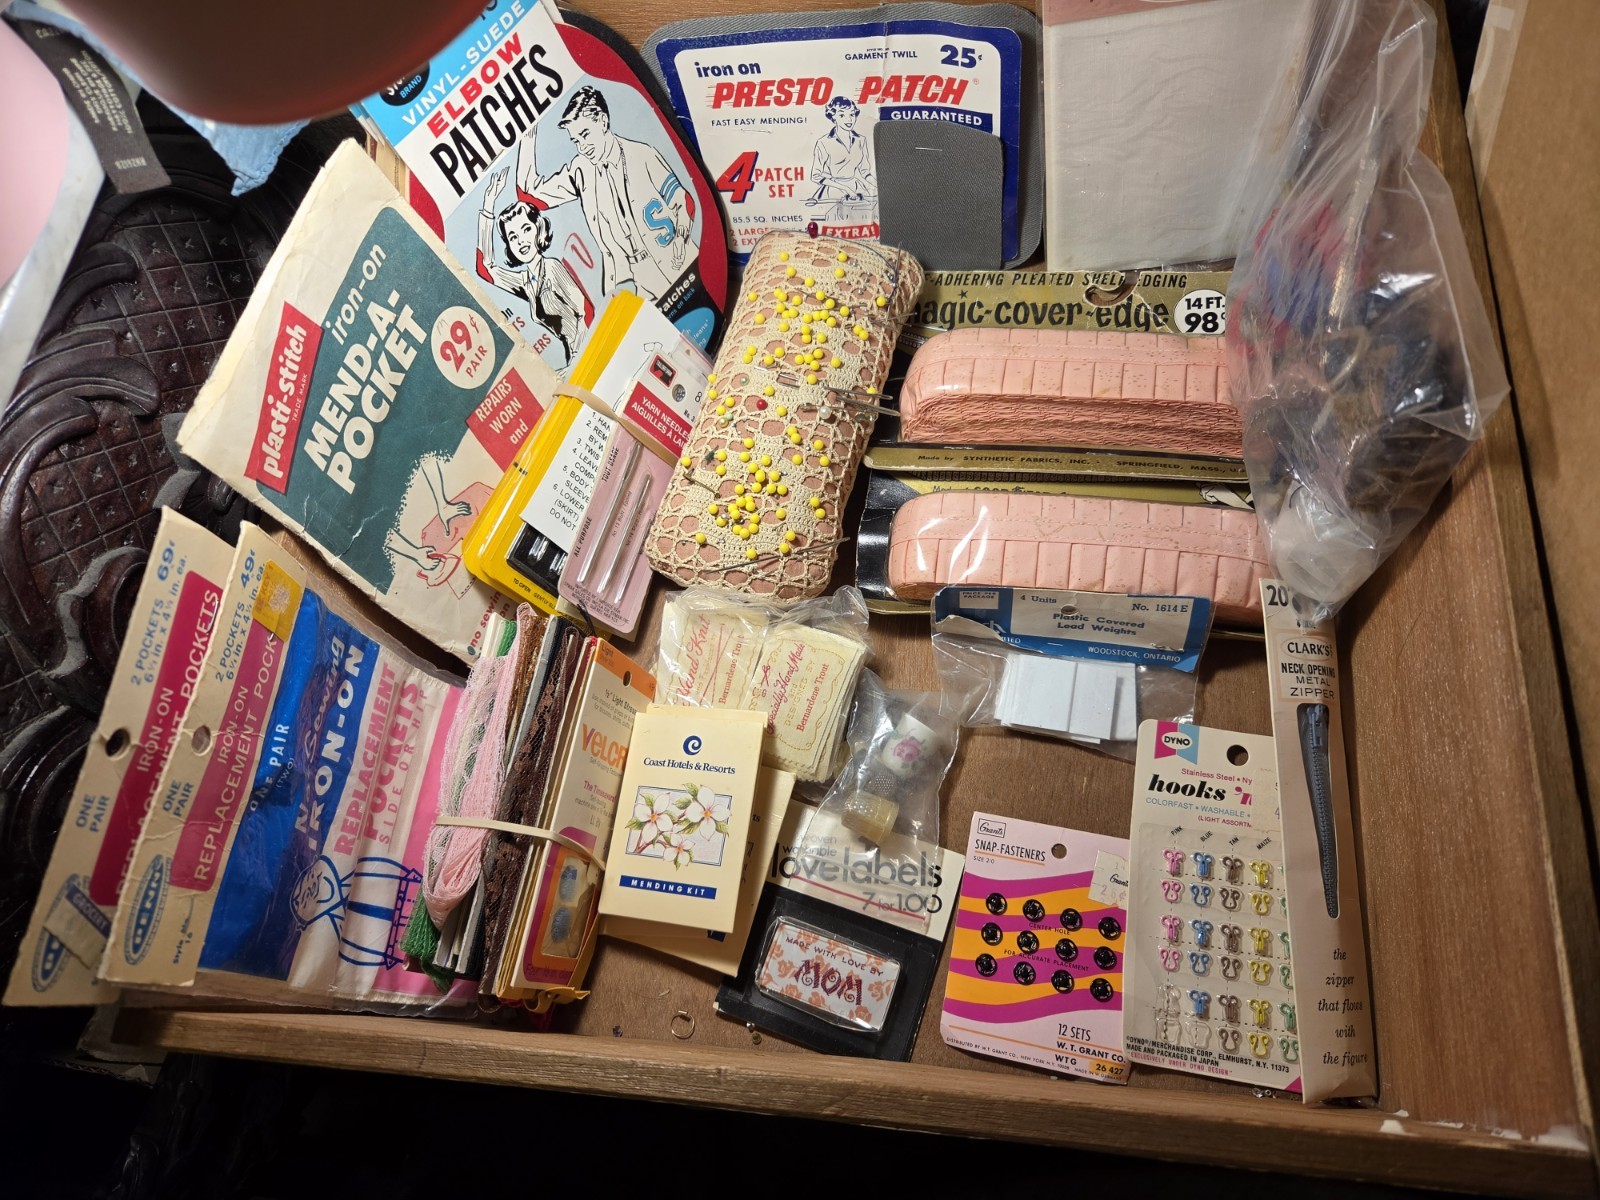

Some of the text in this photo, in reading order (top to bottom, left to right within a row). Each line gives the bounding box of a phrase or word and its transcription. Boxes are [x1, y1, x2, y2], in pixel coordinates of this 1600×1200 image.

[845, 51, 918, 61] GARMENT TWILL
[694, 61, 762, 78] iron on
[400, 74, 422, 99] BRAND
[427, 32, 522, 139] ELBOW
[711, 74, 969, 110] PRESTO PATCH
[430, 44, 563, 198] PATCHES
[711, 117, 807, 127] FAST EASY MENDING!
[890, 110, 983, 126] GUARANTEED
[715, 151, 759, 204] 4
[755, 166, 804, 183] PATCH
[768, 184, 795, 198] SET
[732, 216, 751, 224] 85.5
[772, 215, 803, 223] INCHES
[826, 226, 876, 238] EXTRA!
[1011, 273, 1075, 287] PLEATED
[1136, 274, 1188, 288] DGING
[325, 243, 387, 346] iron-on
[1185, 296, 1226, 310] 14 FT.
[440, 313, 480, 374] 29¢
[465, 345, 488, 379] PAIR
[262, 323, 307, 479] plasti-stitch
[291, 373, 308, 423] TRADE MARK
[327, 303, 428, 495] POCKET
[474, 378, 513, 422] REPAIRS
[641, 396, 661, 417] YARN
[489, 397, 523, 434] WORN
[631, 401, 667, 434] AIGUILLES
[509, 418, 529, 445] and
[573, 516, 593, 558] ALL PURPOSE
[512, 577, 532, 594] TO OPEN
[1031, 595, 1057, 604] Units
[1131, 603, 1149, 612] No.
[1052, 613, 1145, 629] Plastic Covered
[1057, 622, 1137, 636] Lead Weights
[180, 588, 219, 700] POCKETS
[219, 602, 246, 668] POCKETS
[1143, 652, 1181, 663] ONTARIO
[1287, 641, 1330, 657] CLARK'S
[1281, 662, 1336, 679] NECK OPENING
[1295, 675, 1331, 687] METAL
[796, 663, 830, 733] Bernardene Trout
[1290, 687, 1334, 699] ZIPPER
[136, 686, 175, 772] IRON-ON
[217, 686, 249, 764] IRON-ON
[269, 723, 290, 767] PAIR
[308, 644, 364, 851] IRON-ON
[1163, 735, 1191, 746] DYNO
[193, 633, 279, 880] REPLACEMENT POCK
[333, 661, 396, 856] REPLACEMENT
[363, 680, 419, 840] POCKETS
[378, 688, 428, 845] SIDE OR HIP
[643, 756, 736, 775] Coast Hotels & Resorts
[1181, 768, 1236, 782] Stainless Steel
[161, 780, 182, 813] ONE
[1148, 773, 1227, 801] hooks
[173, 782, 194, 818] PAIR
[1145, 797, 1245, 818] COLORFAST WASHABLE
[76, 794, 95, 828] ONE
[89, 795, 110, 833] PAIR
[1170, 826, 1184, 836] PINK
[1200, 830, 1214, 842] BLUE
[1228, 836, 1240, 846] TAN
[974, 839, 1046, 862] SNAP-FASTENERS
[1256, 837, 1272, 850] MAIZE
[630, 878, 706, 897] MENDING KIT
[862, 891, 876, 911] 7
[1028, 922, 1070, 936] CENTER HOLE
[785, 936, 884, 977] MADE WITH LOVE BY
[1018, 952, 1050, 963] ACCURATE
[1053, 959, 1089, 972] PLACEMENT
[1333, 948, 1347, 960] the
[794, 960, 862, 1006] MOM
[1325, 972, 1355, 988] zipper
[1318, 998, 1339, 1012] that
[1058, 1023, 1091, 1042] 12 SETS
[1334, 1025, 1356, 1038] with
[1056, 1041, 1069, 1050] W.
[1078, 1046, 1110, 1059] GRANT
[1111, 1053, 1127, 1064] CO.
[1126, 1043, 1142, 1053] MADE
[1143, 1046, 1155, 1055] AND
[1156, 1049, 1189, 1061] PACKAGED
[1198, 1056, 1220, 1067] JAPAN
[1218, 1053, 1255, 1068] ELMHURST,
[1255, 1060, 1269, 1070] N.Y.
[1270, 1063, 1290, 1073] 11373
[1322, 1051, 1339, 1065] the
[1054, 1053, 1124, 1075] WTG 26 427
